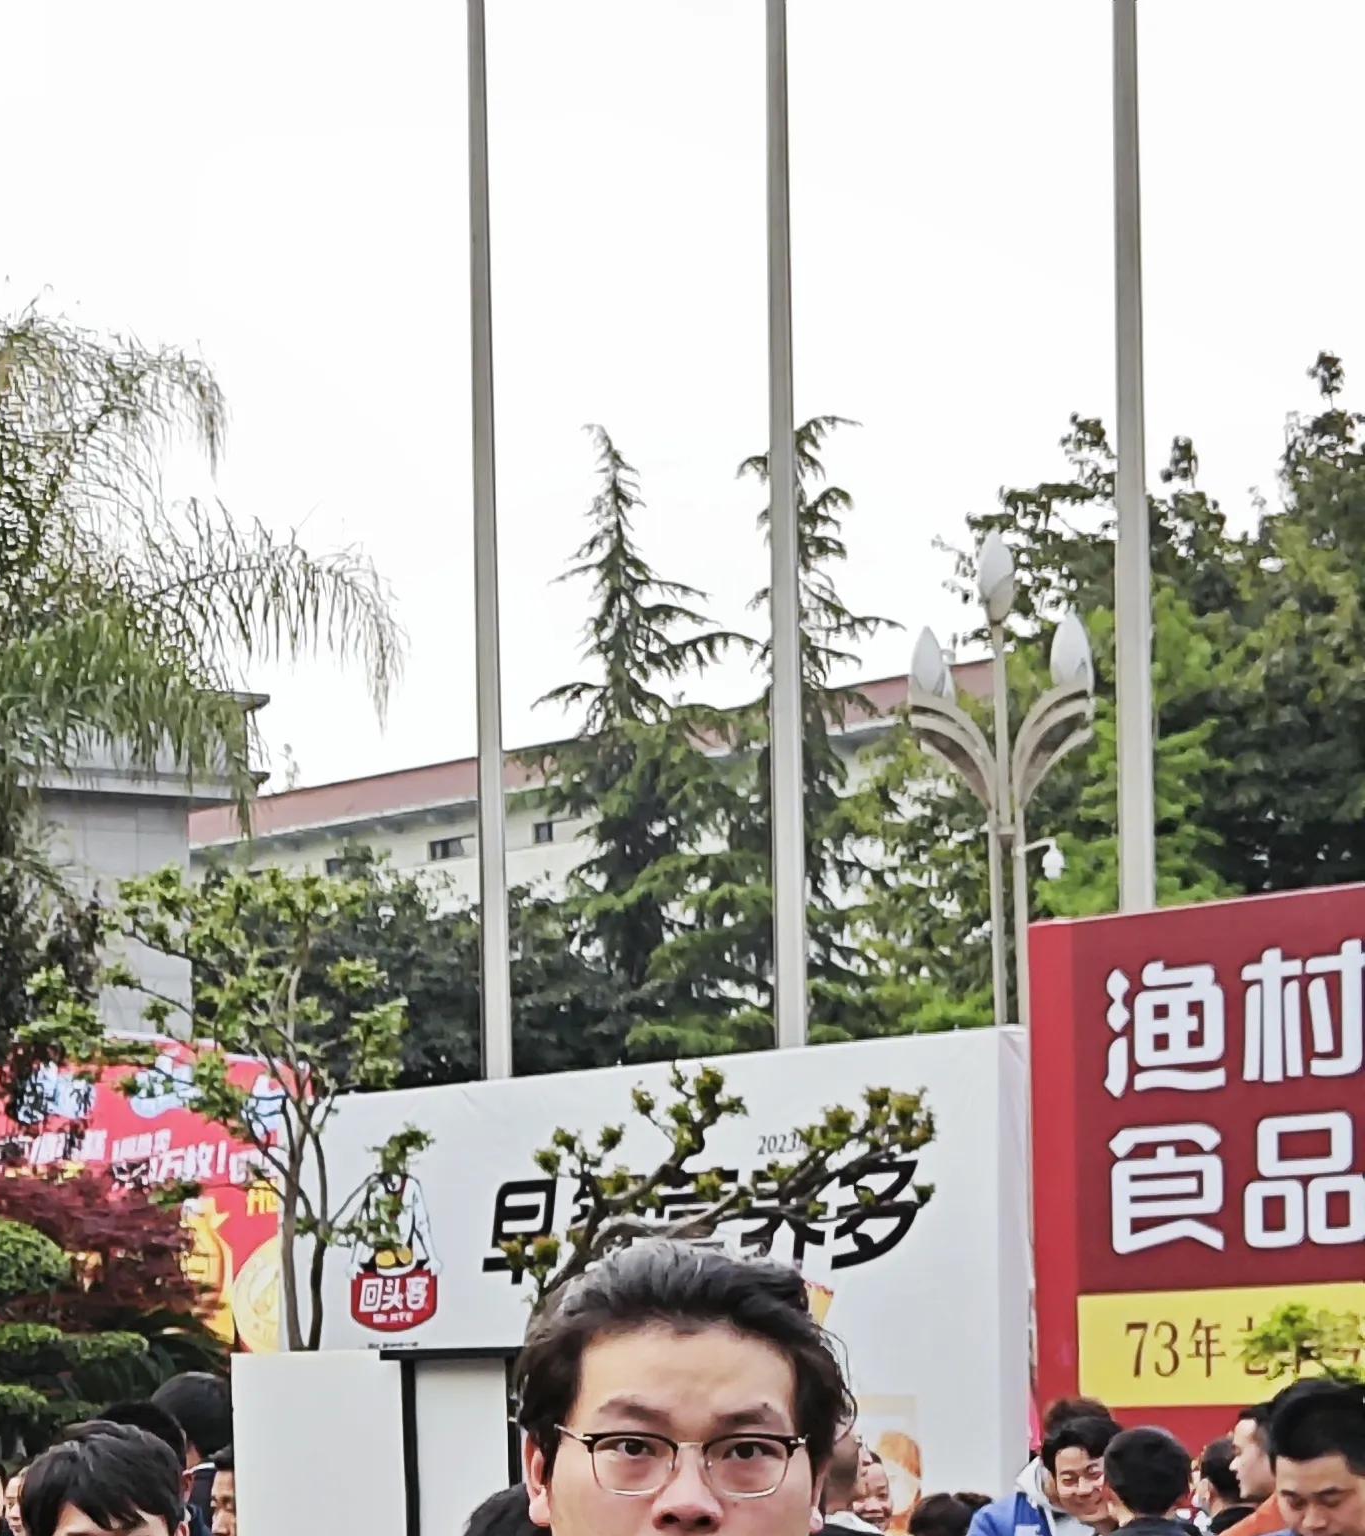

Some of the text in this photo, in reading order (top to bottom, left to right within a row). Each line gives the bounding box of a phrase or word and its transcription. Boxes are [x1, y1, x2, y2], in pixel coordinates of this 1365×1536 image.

[1104, 938, 1365, 1098] 渔村
[757, 1131, 804, 1156] 2023
[1108, 1111, 1365, 1254] 食品
[359, 1276, 429, 1313] 回头客
